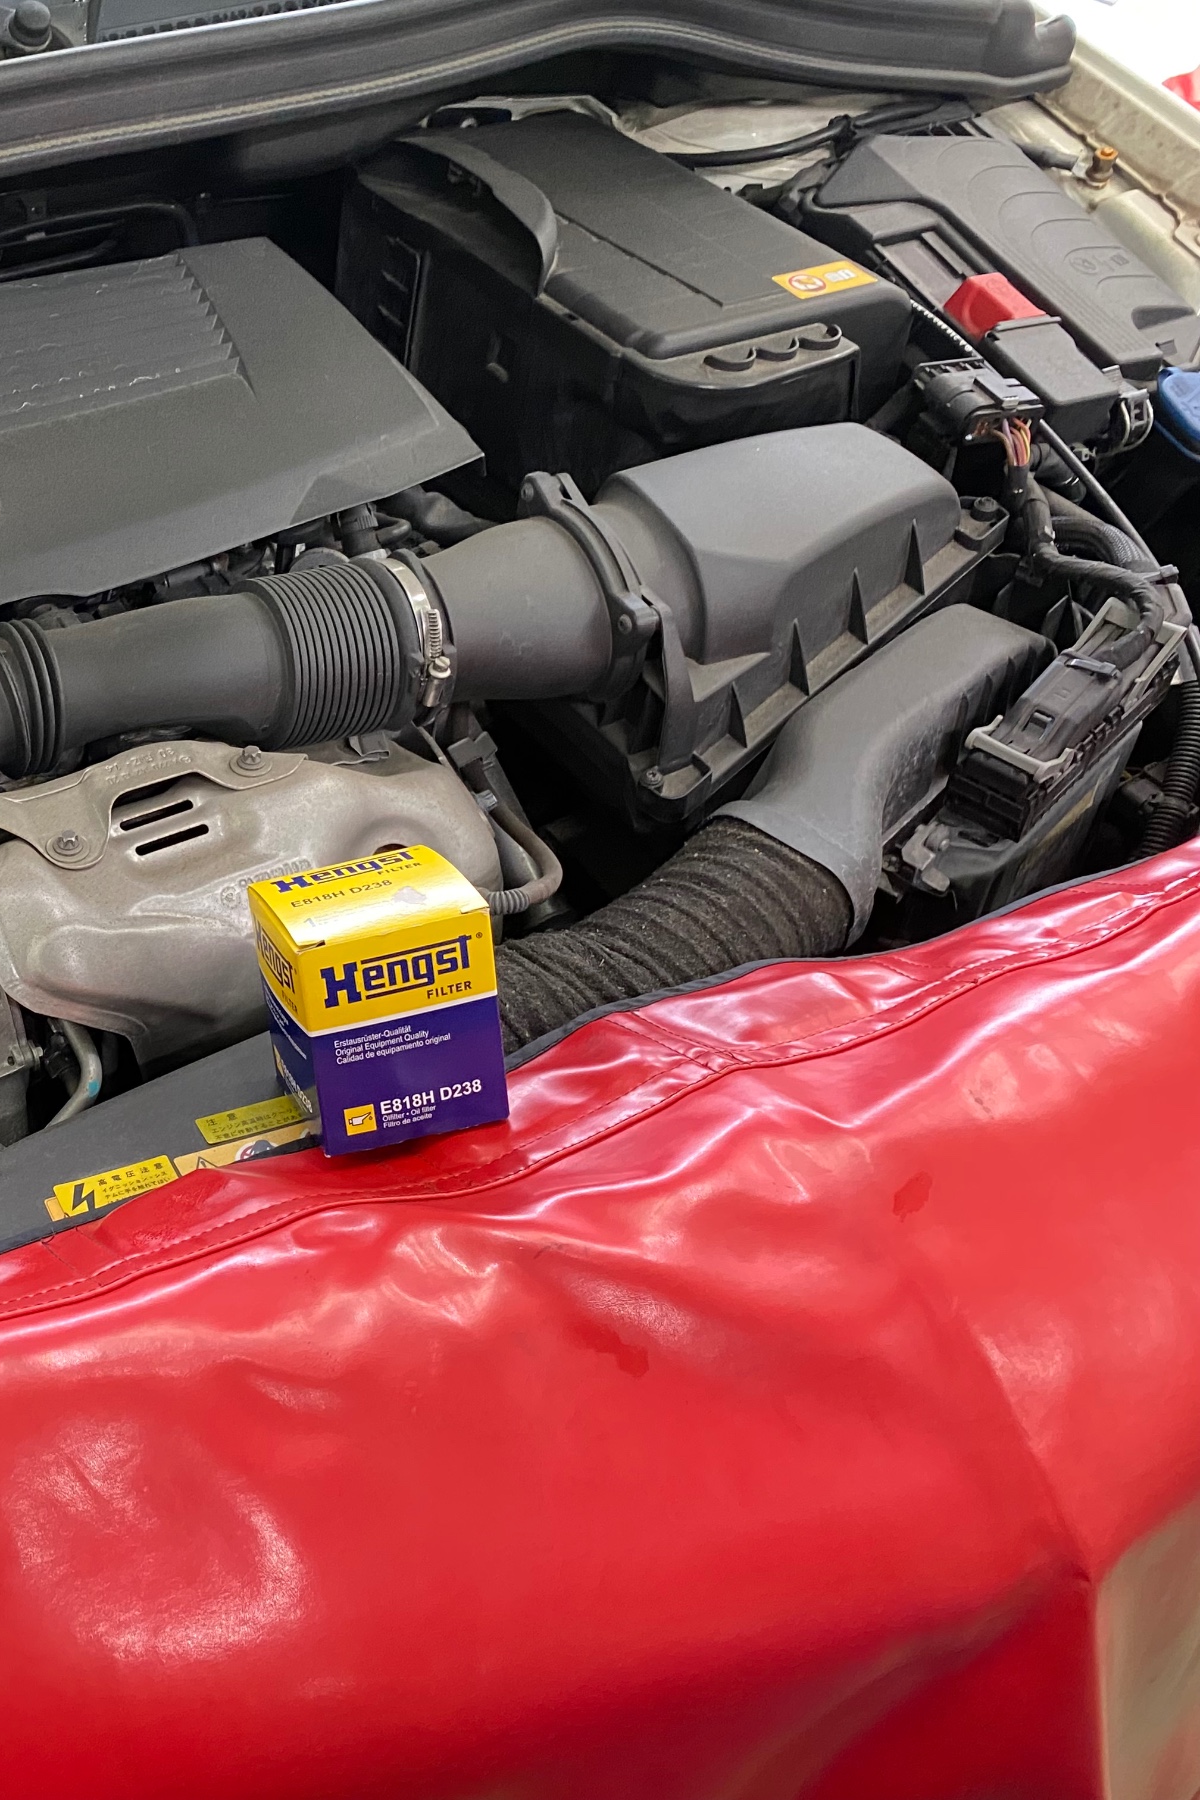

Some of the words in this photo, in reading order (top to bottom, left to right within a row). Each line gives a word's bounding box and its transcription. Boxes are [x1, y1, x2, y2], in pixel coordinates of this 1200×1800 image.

[270, 850, 414, 893] Hengst
[377, 862, 422, 876] FILTER
[291, 890, 346, 908] E818H
[350, 879, 393, 894] D238
[320, 934, 472, 1008] Hengst
[427, 980, 472, 999] FILTER
[335, 1045, 363, 1057] Original
[364, 1036, 403, 1050] Equipment
[404, 1030, 429, 1041] Quality
[336, 1054, 364, 1065] Calidad
[376, 1040, 424, 1056] equipamiento
[424, 1033, 451, 1045] original
[380, 1090, 435, 1115] E818H
[440, 1079, 482, 1101] D238
[206, 1112, 238, 1126] 注意
[383, 1120, 400, 1128] Filtro
[412, 1113, 432, 1122] aceite
